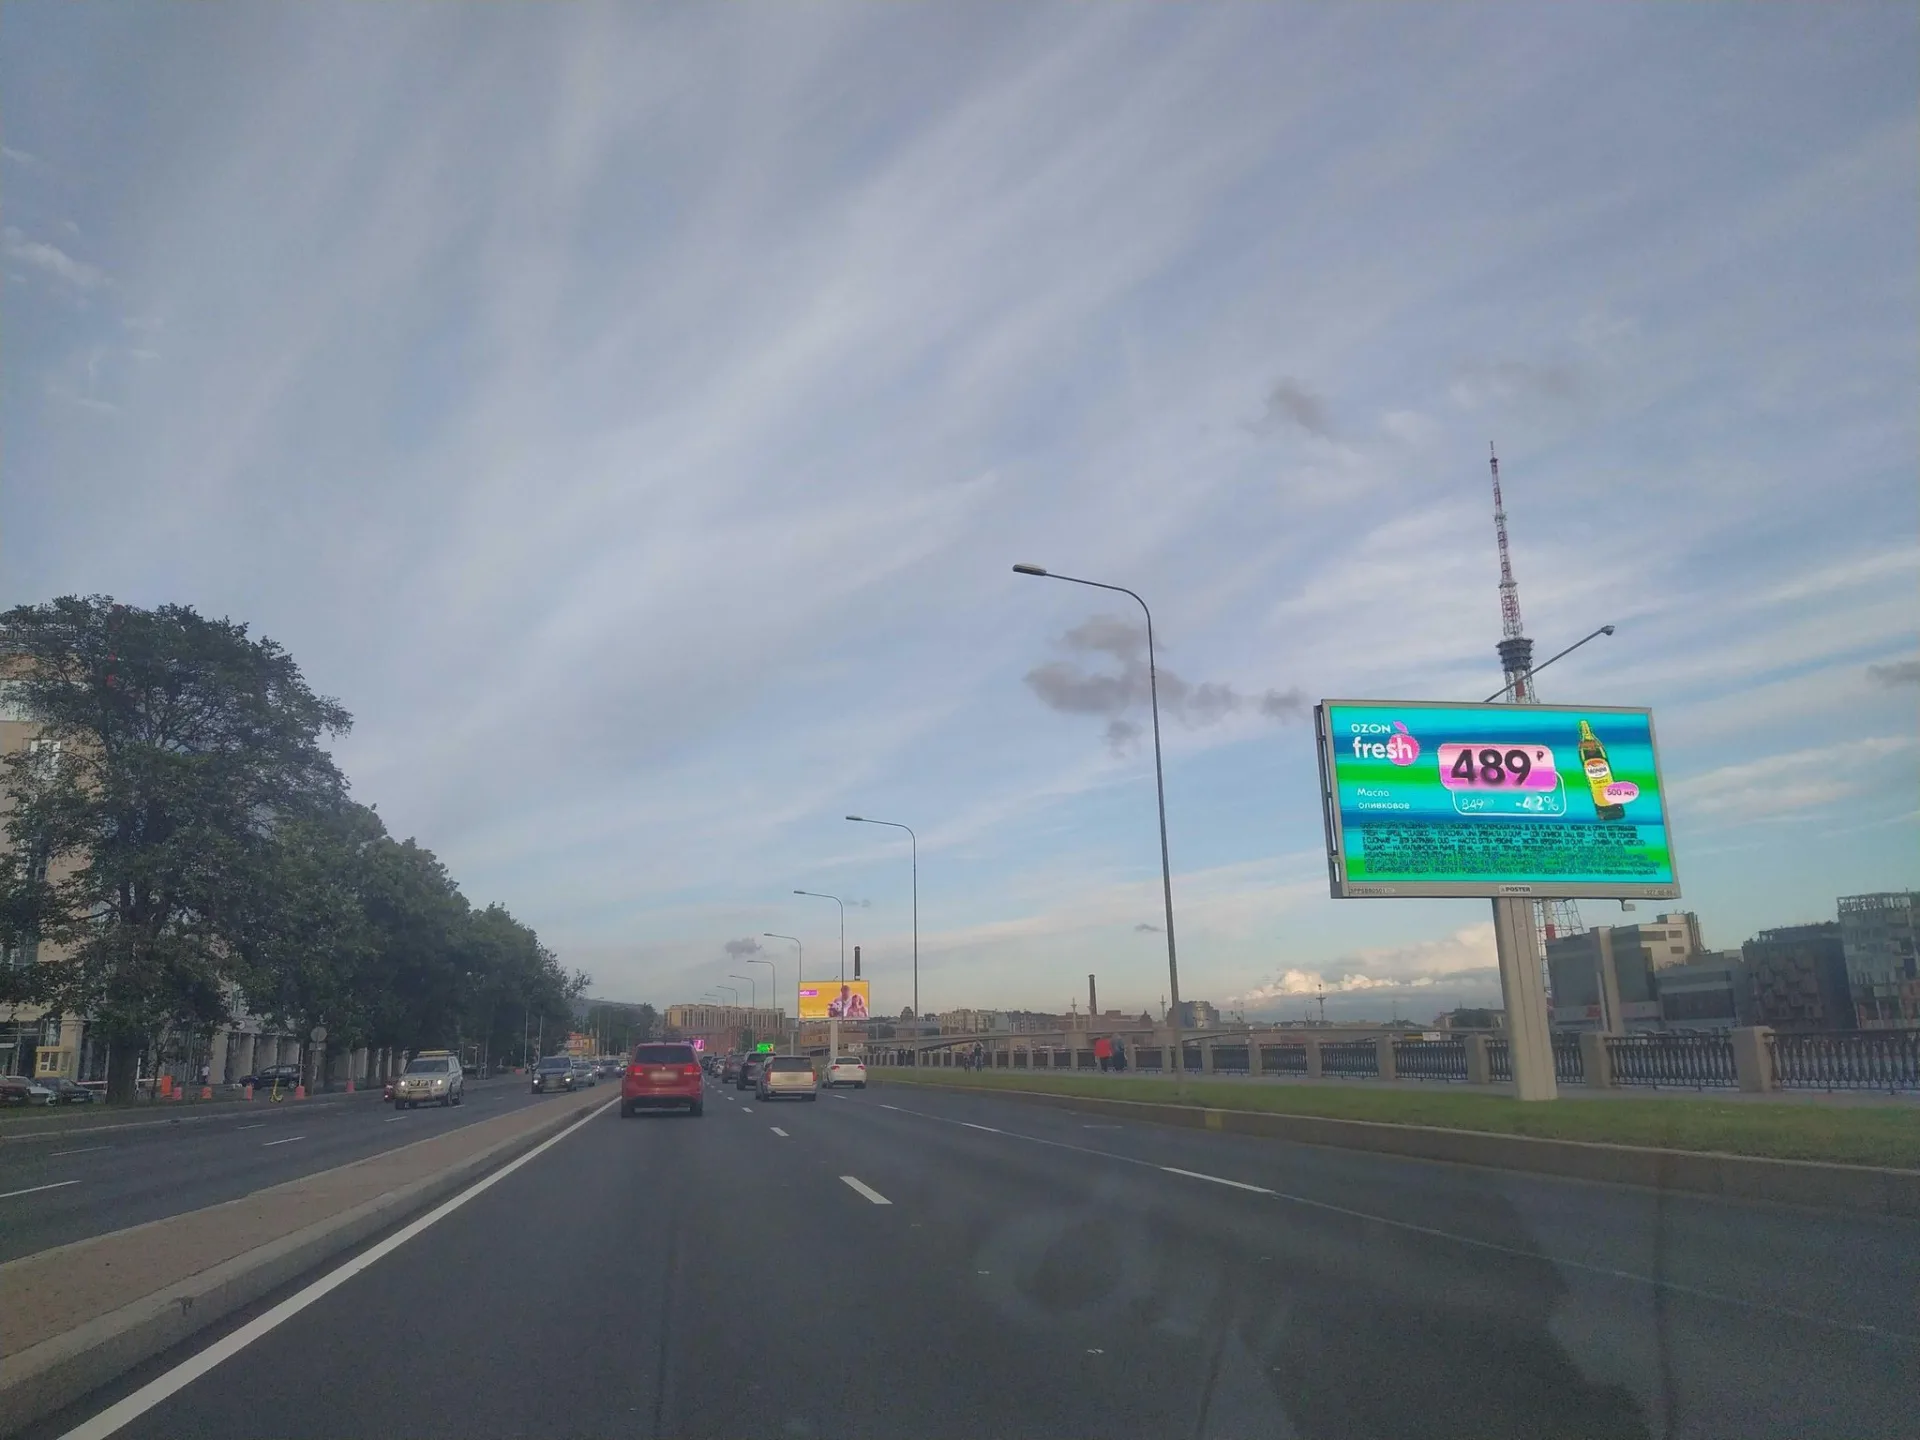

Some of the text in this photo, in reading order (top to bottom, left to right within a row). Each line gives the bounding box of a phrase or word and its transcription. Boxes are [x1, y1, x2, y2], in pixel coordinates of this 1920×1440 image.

[1351, 723, 1391, 733] OZON
[1352, 736, 1413, 759] fresh
[1451, 749, 1531, 786] 489
[1357, 787, 1390, 797] Масло
[1607, 788, 1621, 796] 500
[1358, 802, 1410, 810] оливковое
